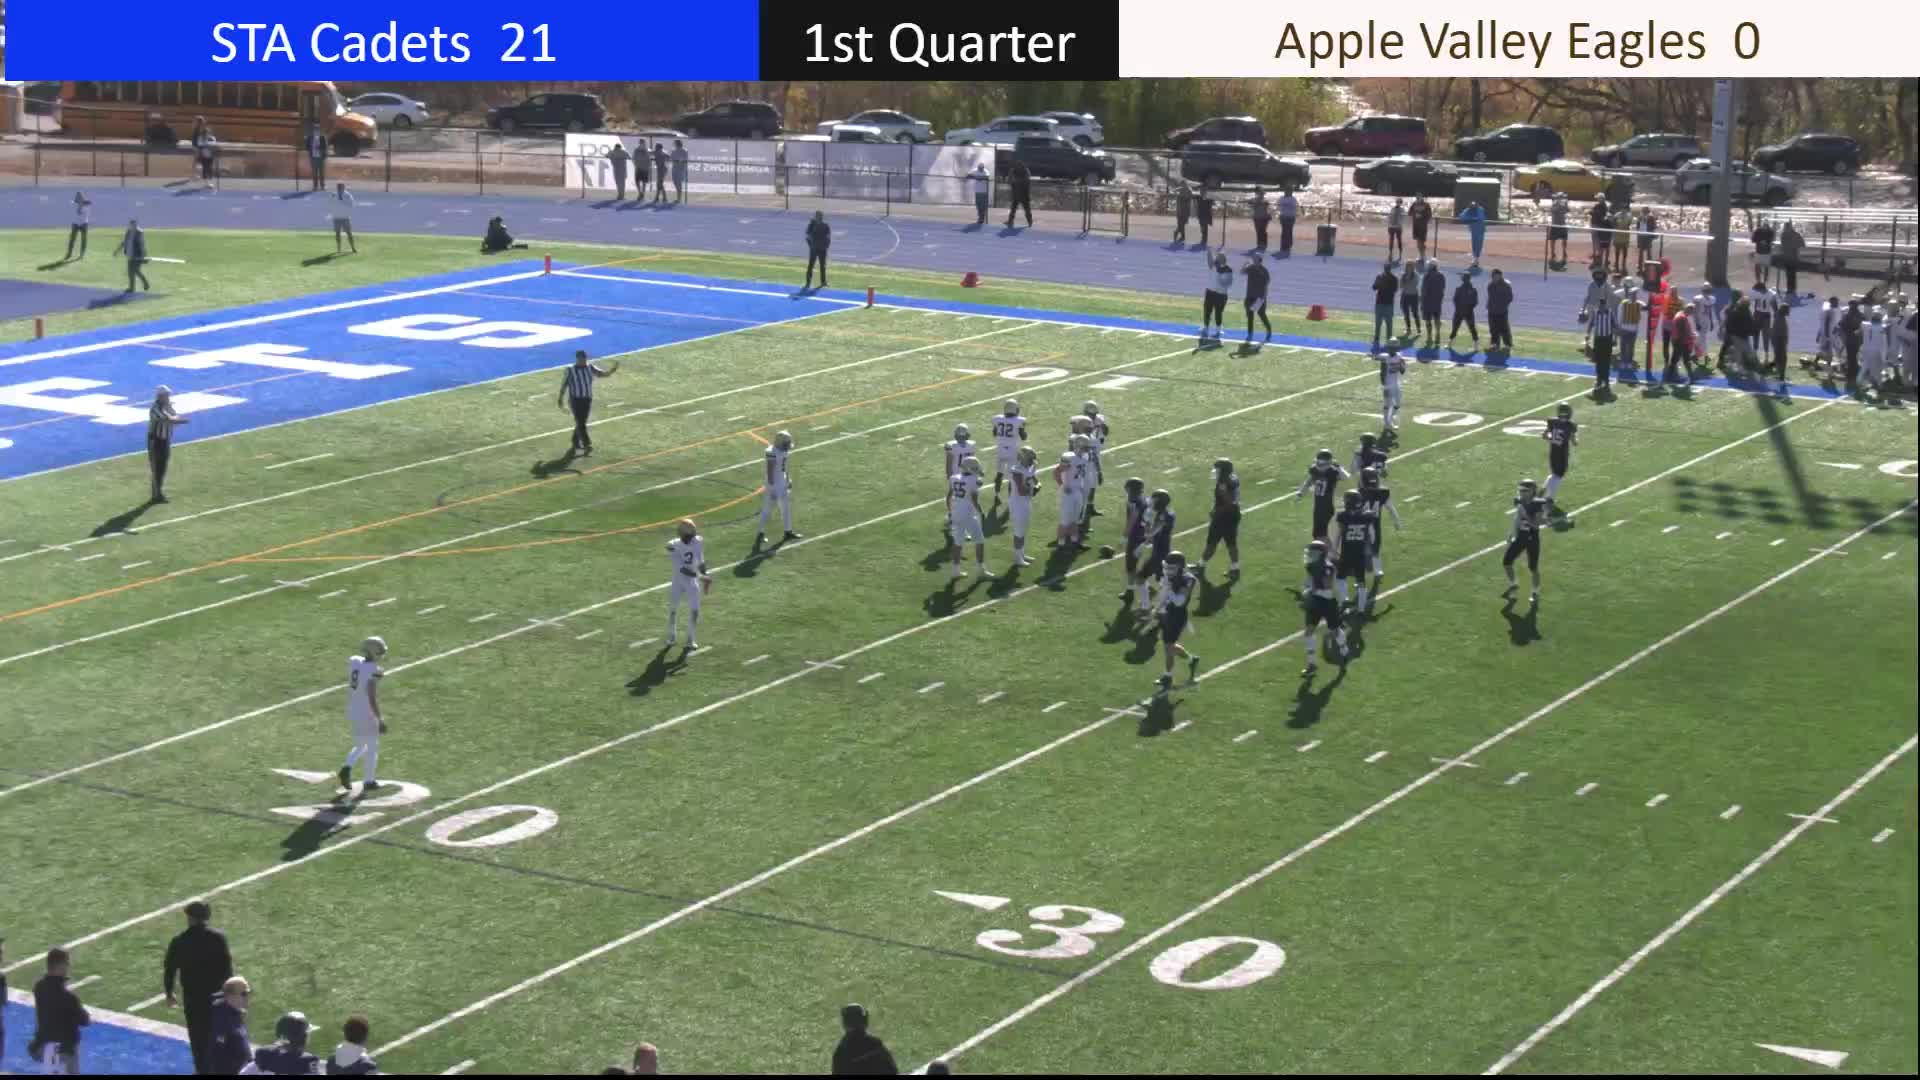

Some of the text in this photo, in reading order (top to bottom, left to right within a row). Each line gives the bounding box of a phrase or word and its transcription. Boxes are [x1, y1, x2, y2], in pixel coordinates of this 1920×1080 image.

[0, 313, 593, 448] ETS
[996, 423, 1014, 438] 32
[1346, 524, 1367, 541] 25
[683, 551, 695, 567] 3
[975, 904, 1287, 990] 30
